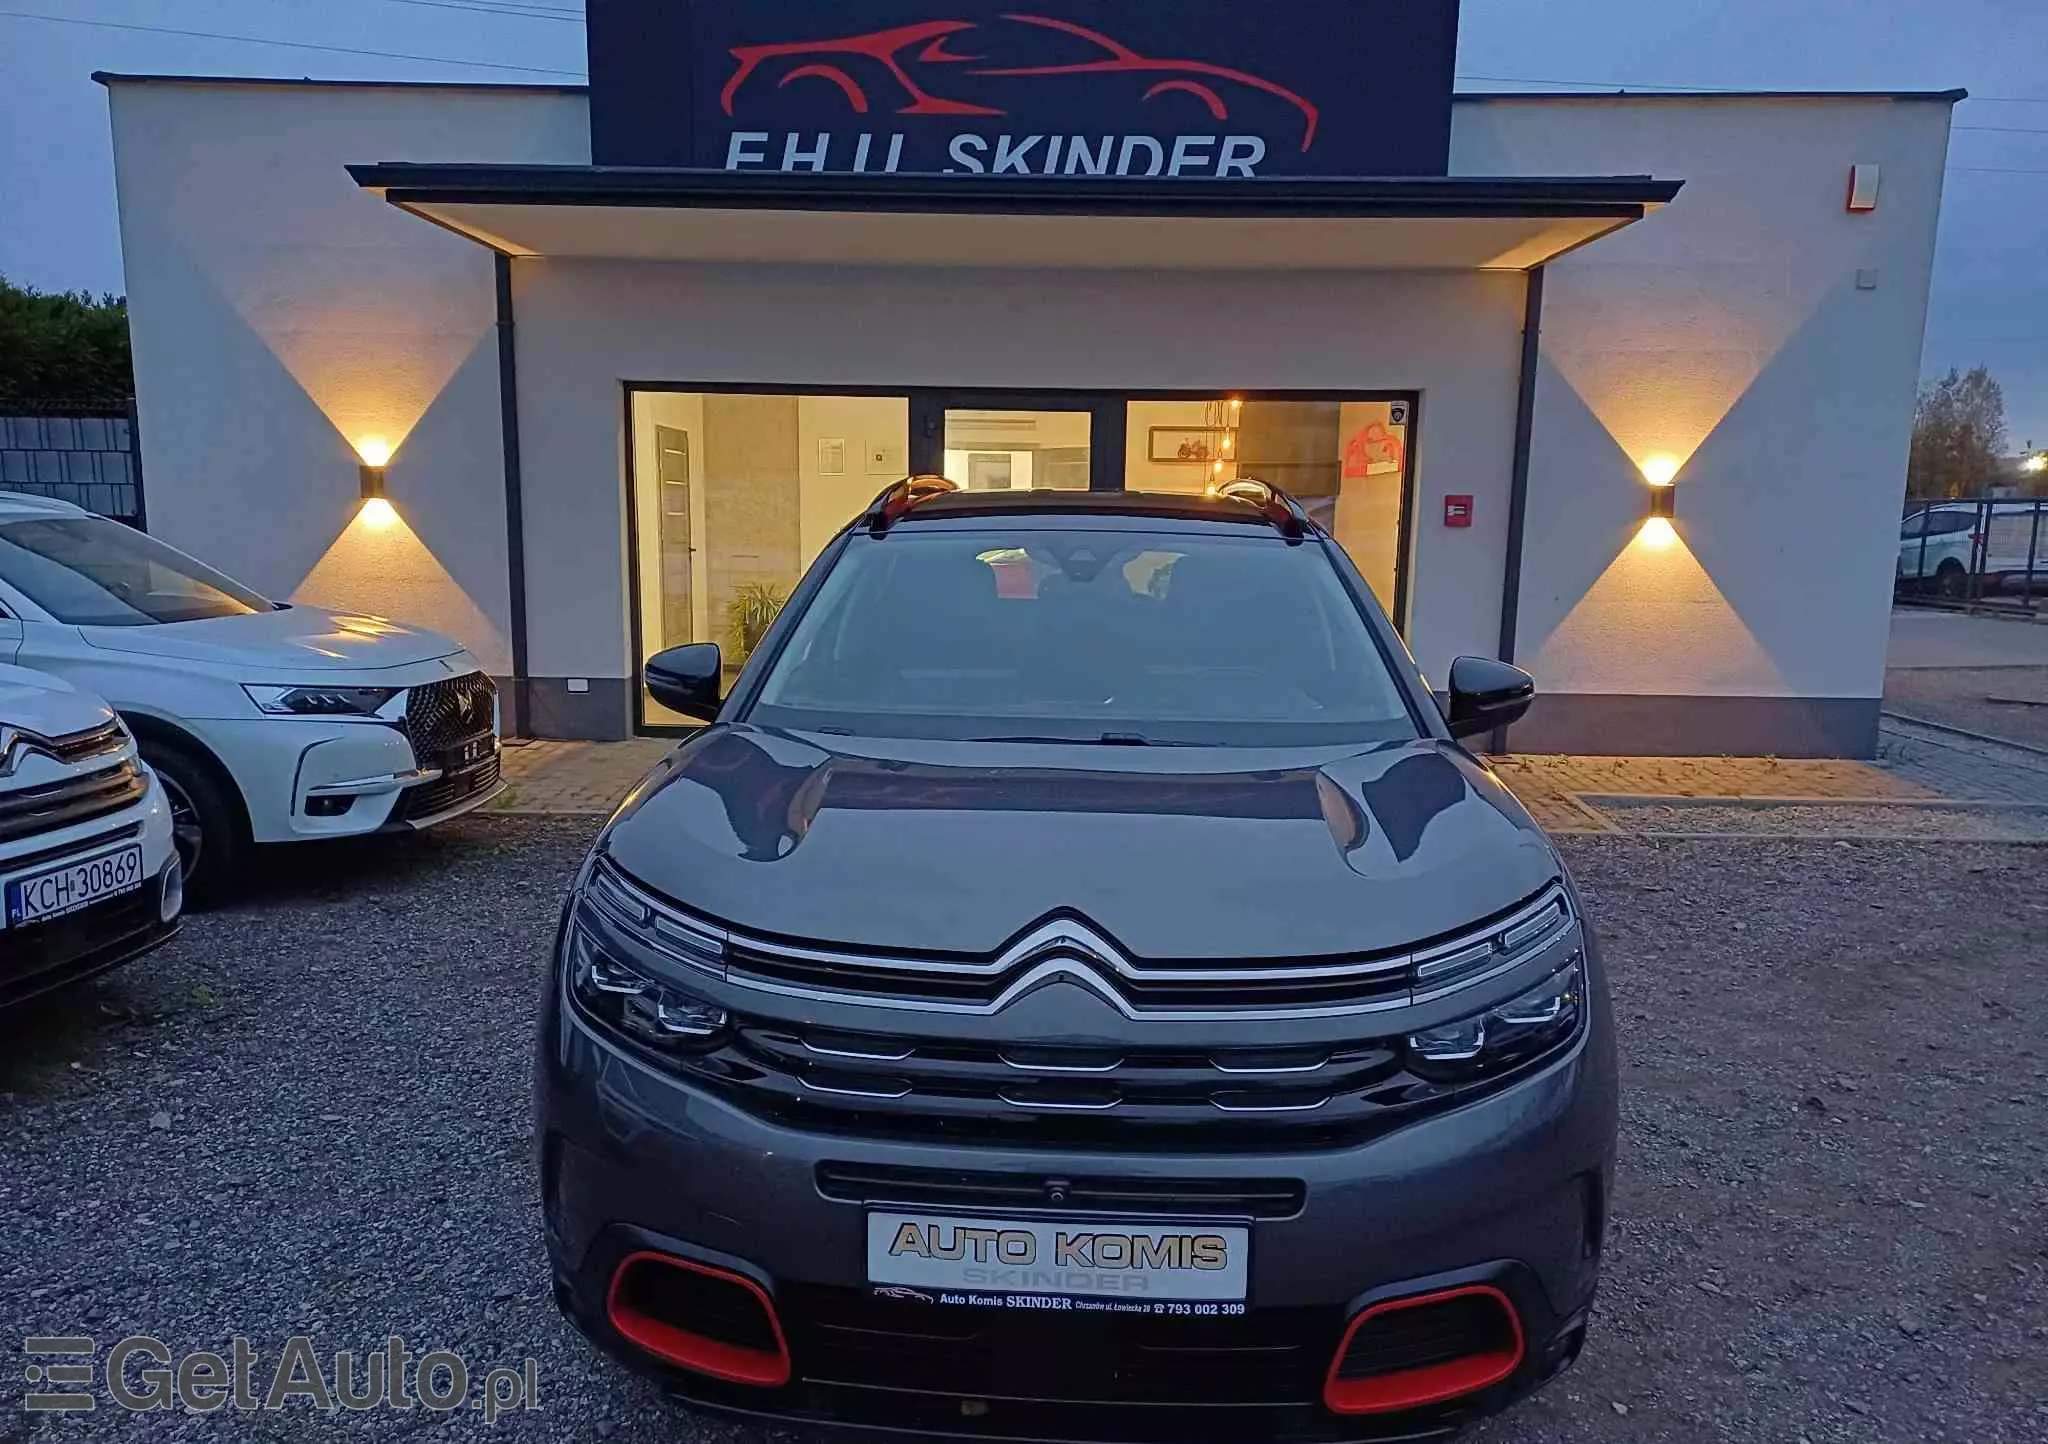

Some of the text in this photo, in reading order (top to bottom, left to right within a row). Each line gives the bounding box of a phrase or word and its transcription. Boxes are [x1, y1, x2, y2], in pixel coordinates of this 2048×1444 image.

[942, 133, 1266, 177] SKINDER
[23, 871, 70, 917] KCH
[76, 851, 138, 898] 30869
[888, 1222, 1228, 1271] AUTO KOMIS
[962, 1267, 1149, 1292] SKINDER
[940, 1293, 966, 1305] Auto
[968, 1294, 1003, 1306] Komis
[1006, 1295, 1073, 1310] SKINDER
[1167, 1303, 1191, 1314] 793
[1194, 1303, 1219, 1315] 002
[1221, 1303, 1246, 1315] 309
